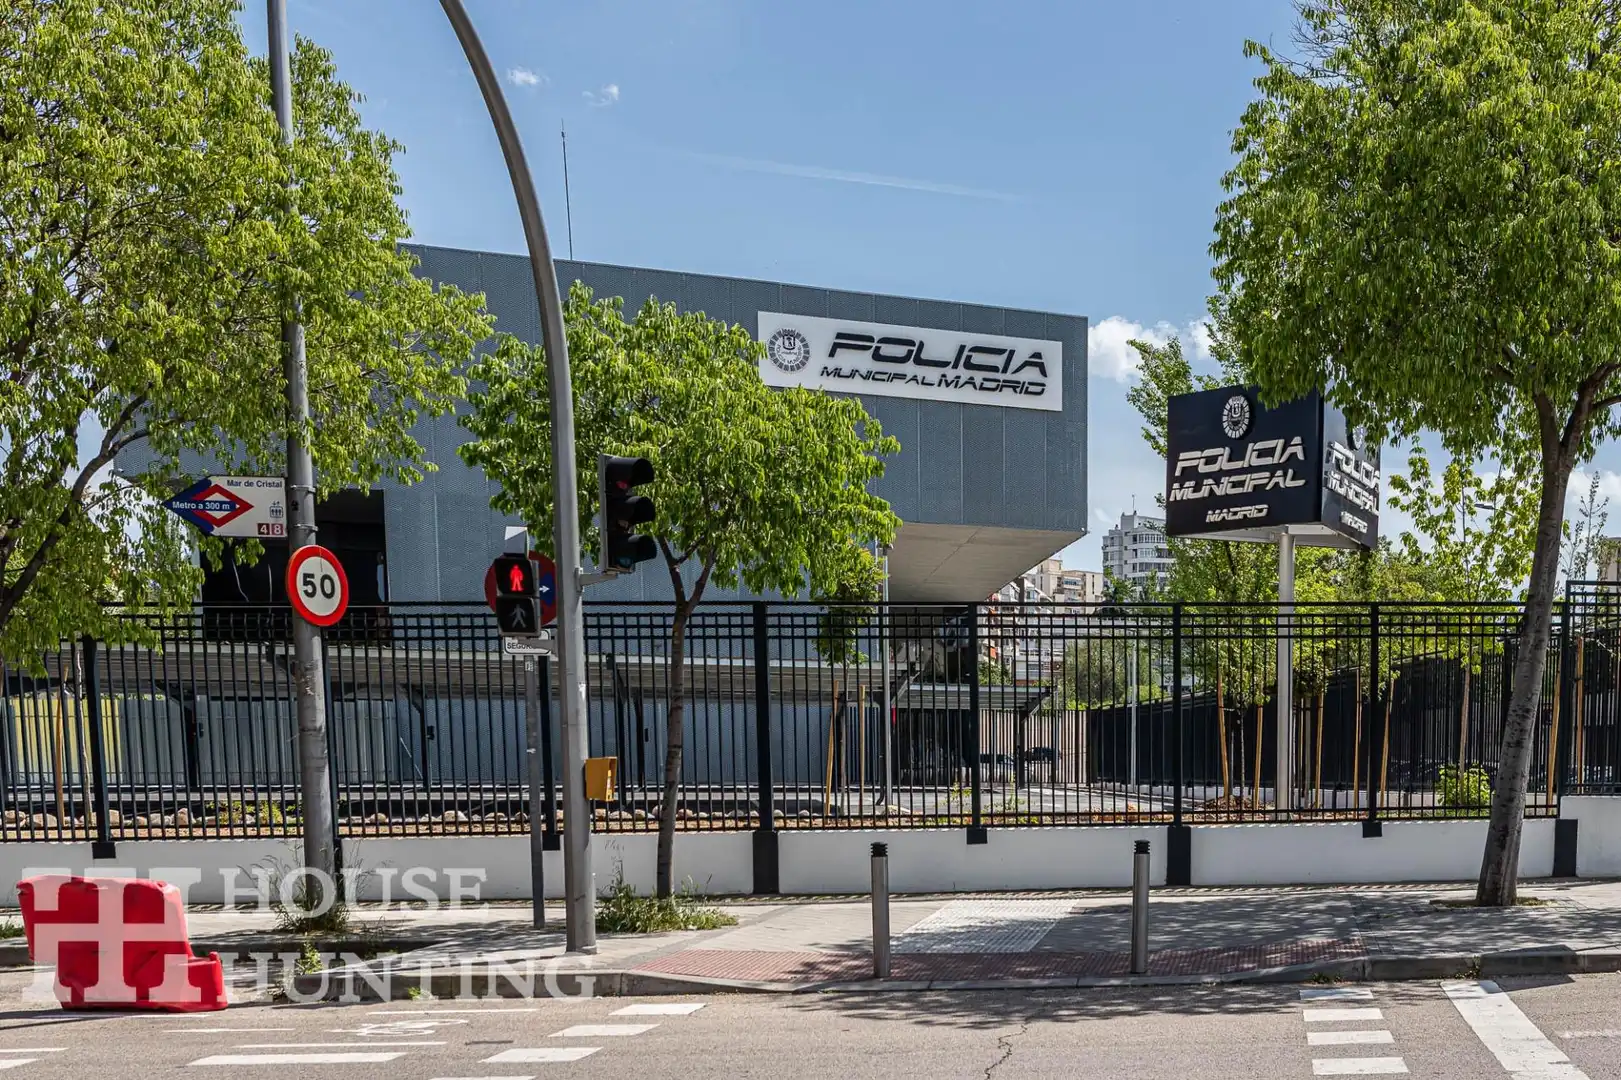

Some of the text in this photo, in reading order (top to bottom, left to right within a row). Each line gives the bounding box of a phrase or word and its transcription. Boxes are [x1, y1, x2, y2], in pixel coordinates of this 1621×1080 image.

[828, 332, 1048, 378] POLICIA
[820, 366, 1046, 396] MUNICIPAL MADRID
[1174, 436, 1305, 476] POLICIA
[1330, 441, 1380, 493] POLICIA
[226, 480, 283, 488] Mar de Cristal
[1169, 468, 1306, 501] MUNICIPAL
[172, 501, 197, 509] Metro
[197, 502, 204, 510] a
[205, 502, 220, 510] 300
[1205, 504, 1268, 522] MADRID
[260, 524, 281, 535] 4 8
[302, 572, 335, 599] 50
